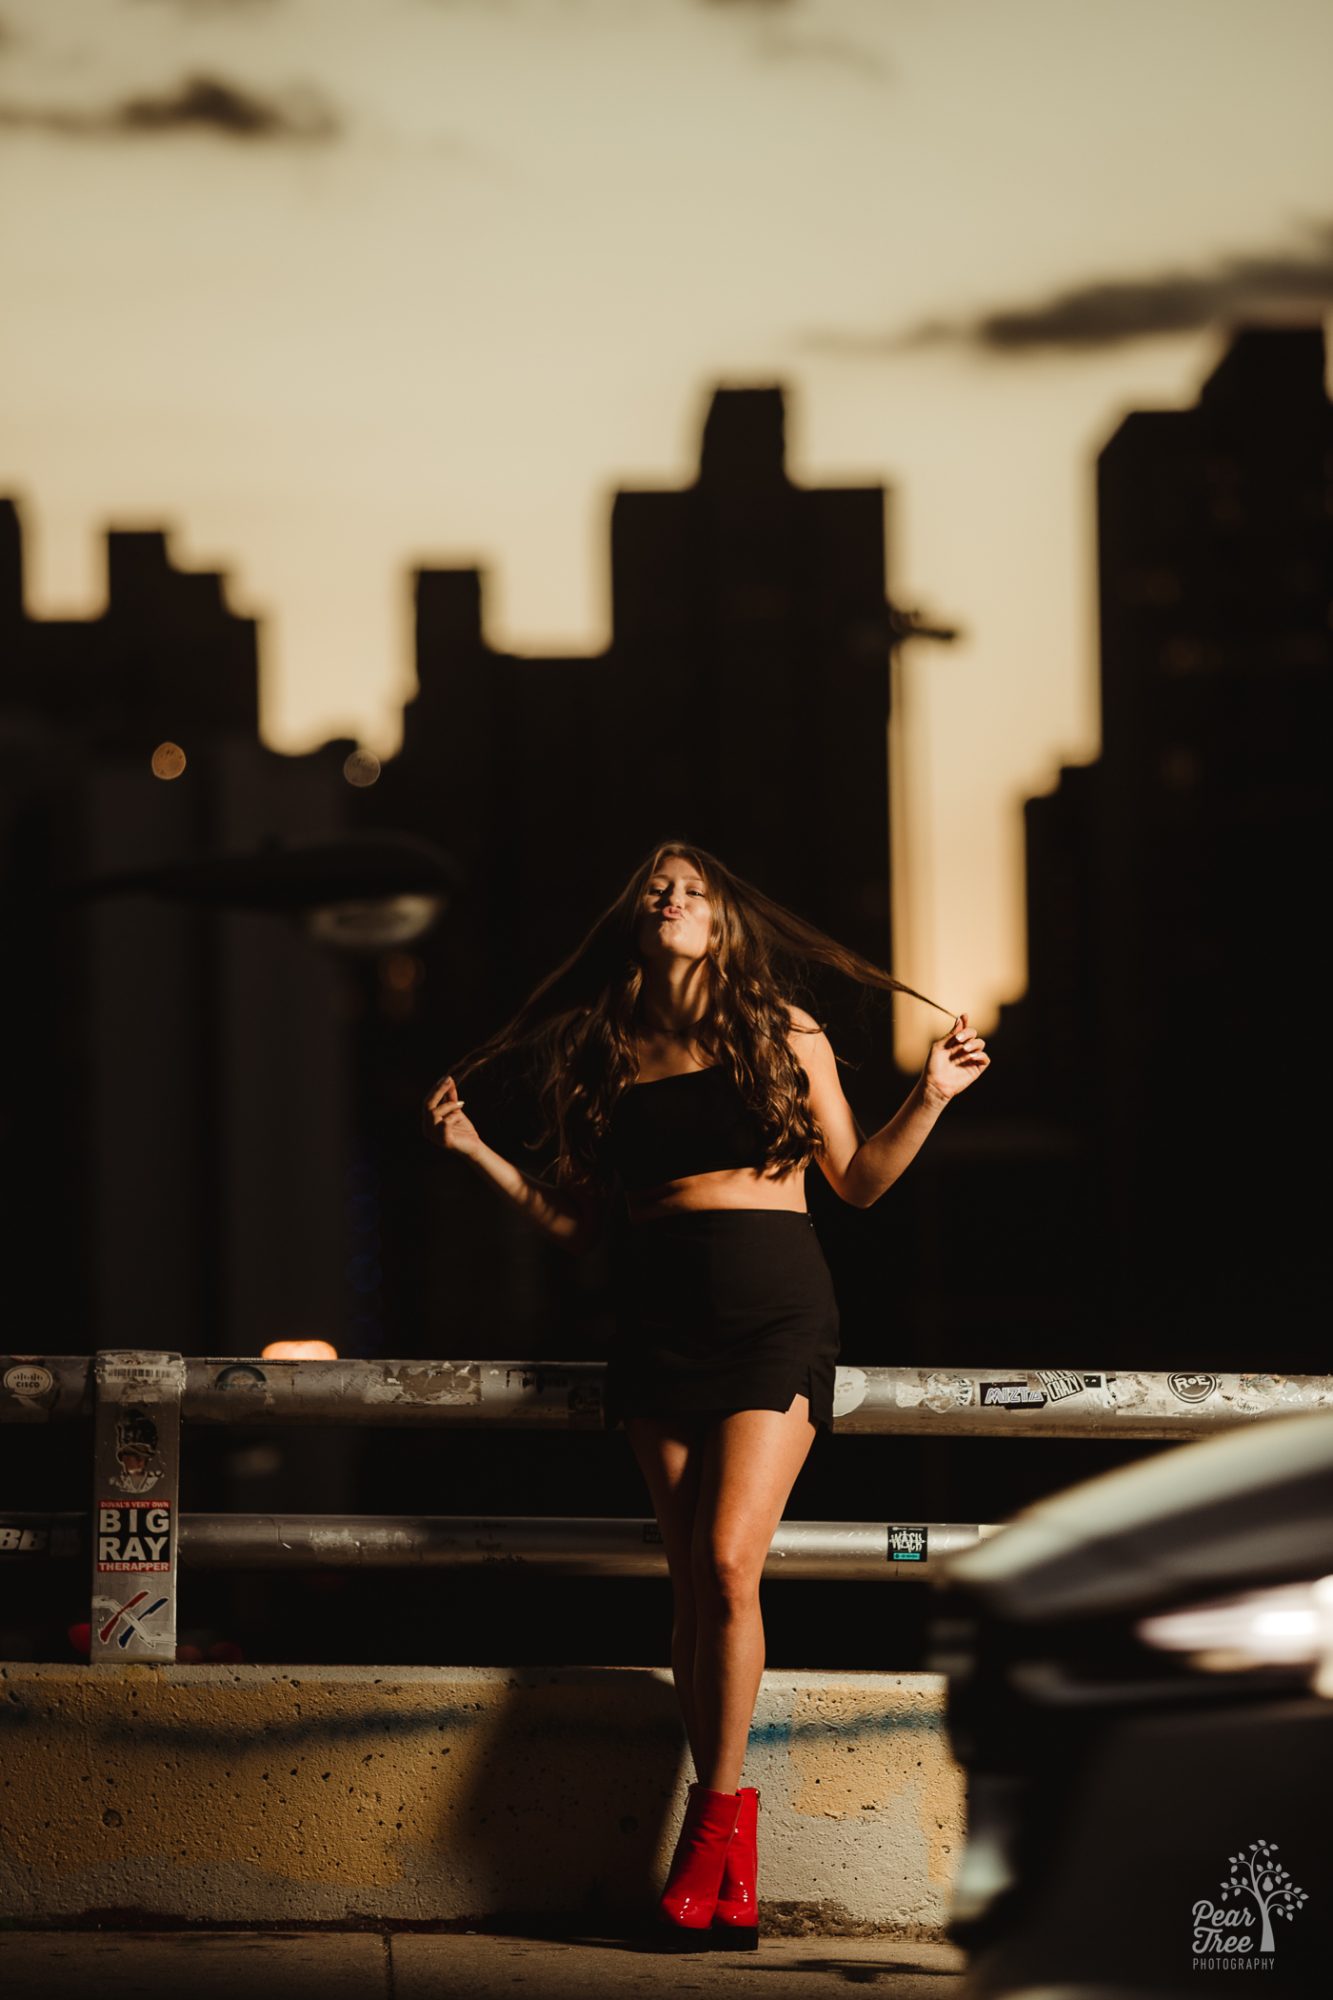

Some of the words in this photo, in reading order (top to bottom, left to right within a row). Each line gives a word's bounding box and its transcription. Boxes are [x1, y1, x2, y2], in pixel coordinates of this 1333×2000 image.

[1047, 1376, 1081, 1400] CRAZY
[99, 1509, 170, 1534] BIG
[99, 1536, 169, 1562] RAY
[99, 1562, 169, 1572] THERAPPER
